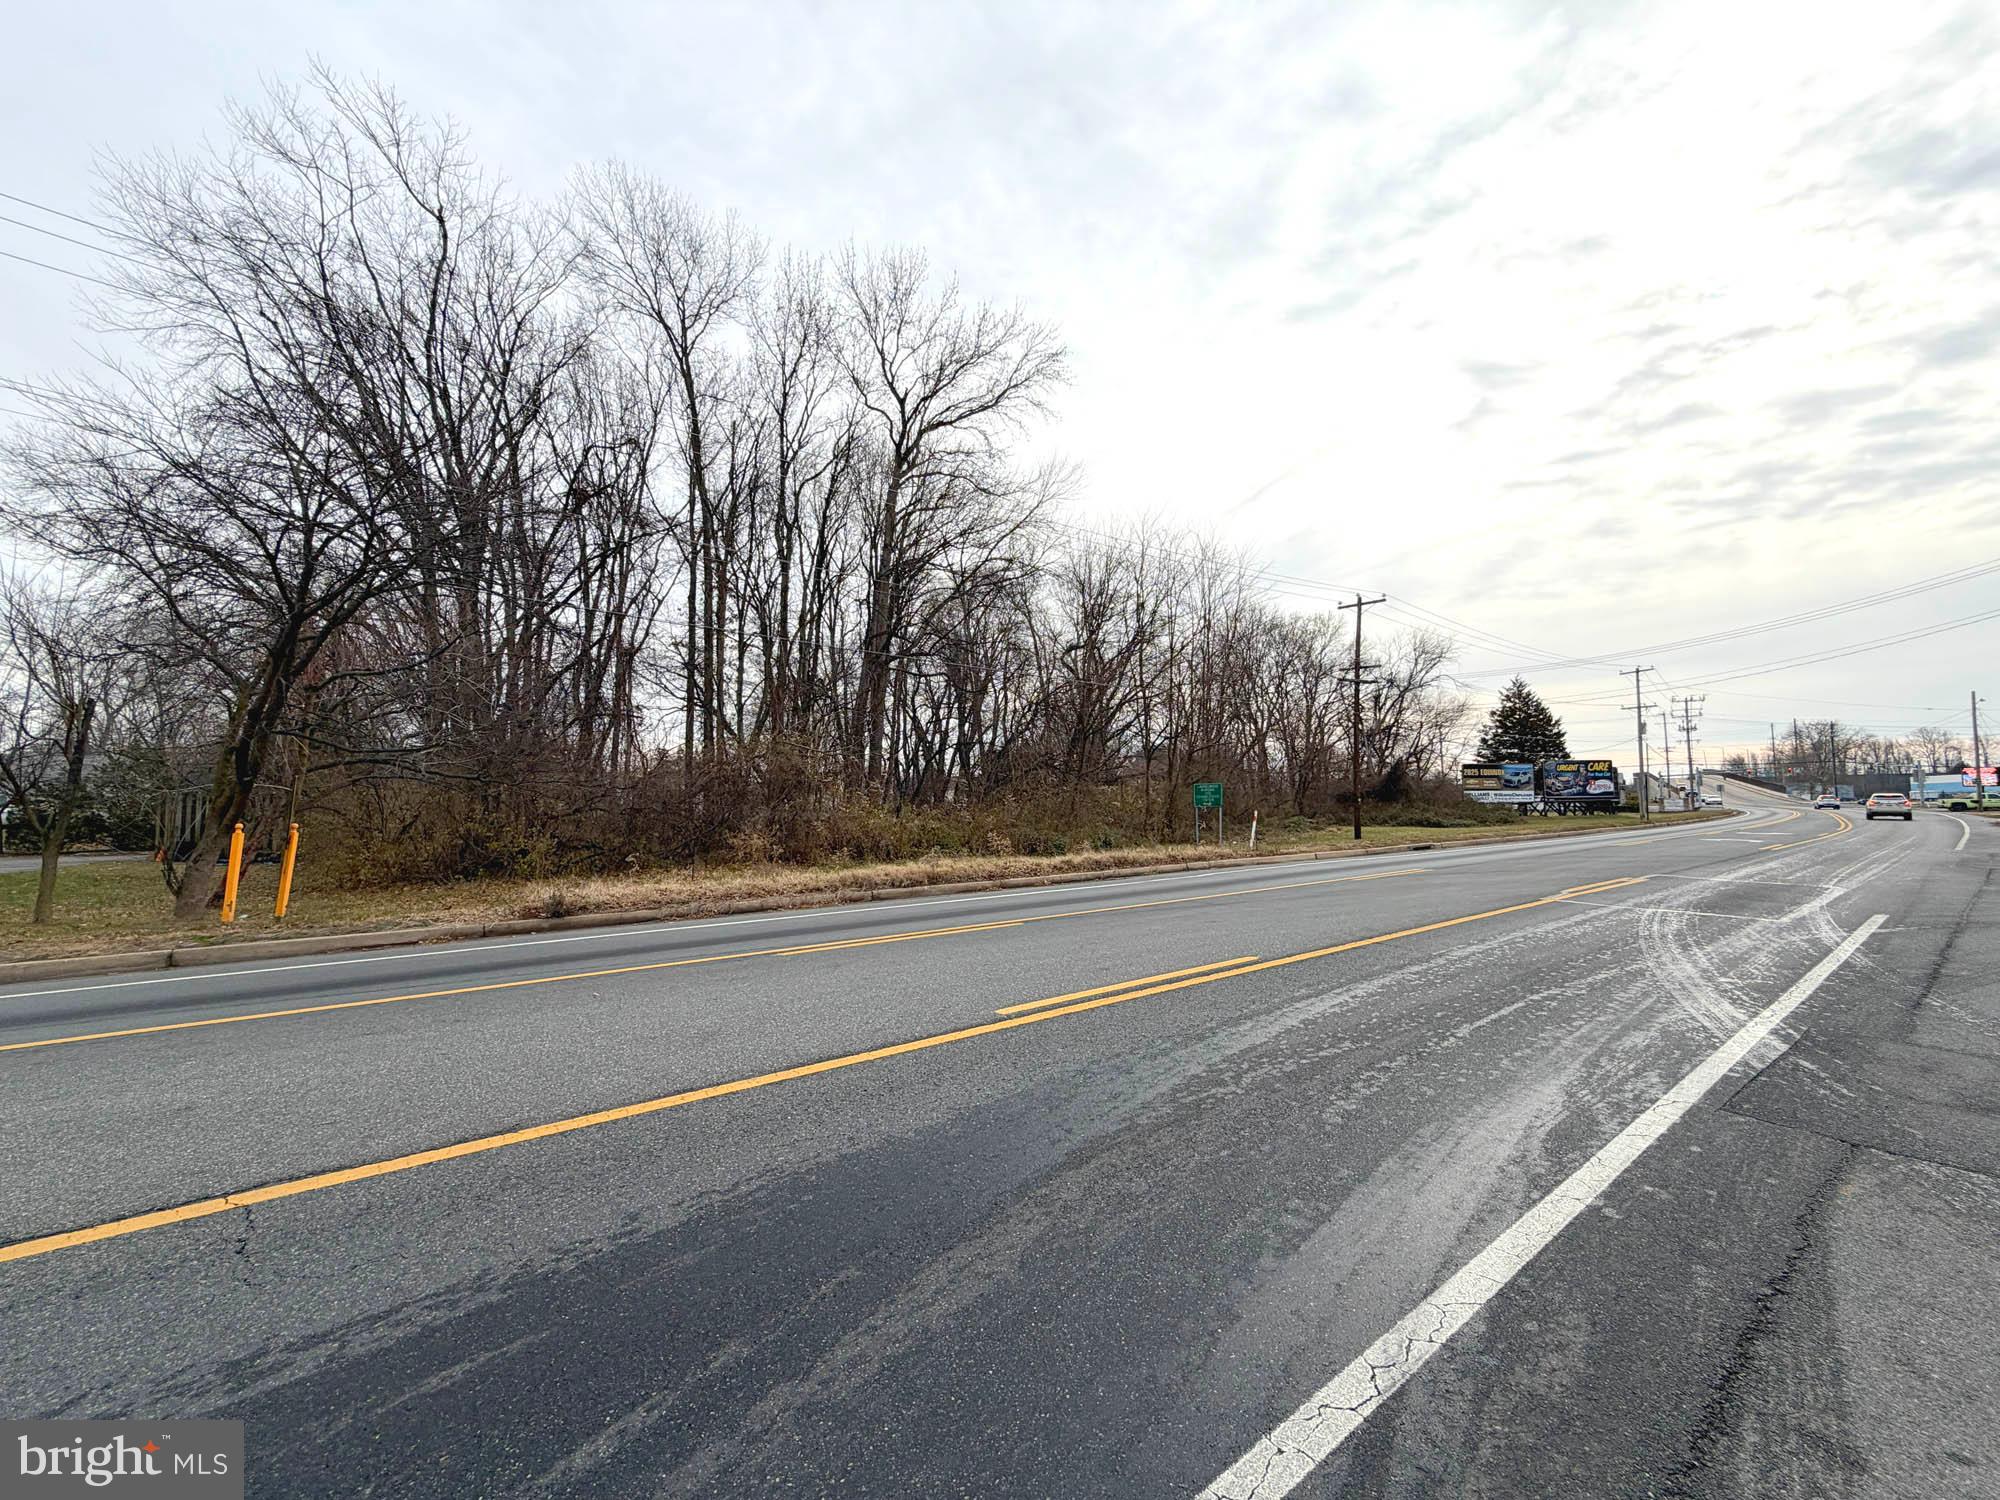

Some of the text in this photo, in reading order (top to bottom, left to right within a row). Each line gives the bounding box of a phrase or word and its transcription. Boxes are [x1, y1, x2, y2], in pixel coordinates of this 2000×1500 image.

[1556, 762, 1610, 772] URGENT CARE
[1463, 768, 1479, 776] 2025
